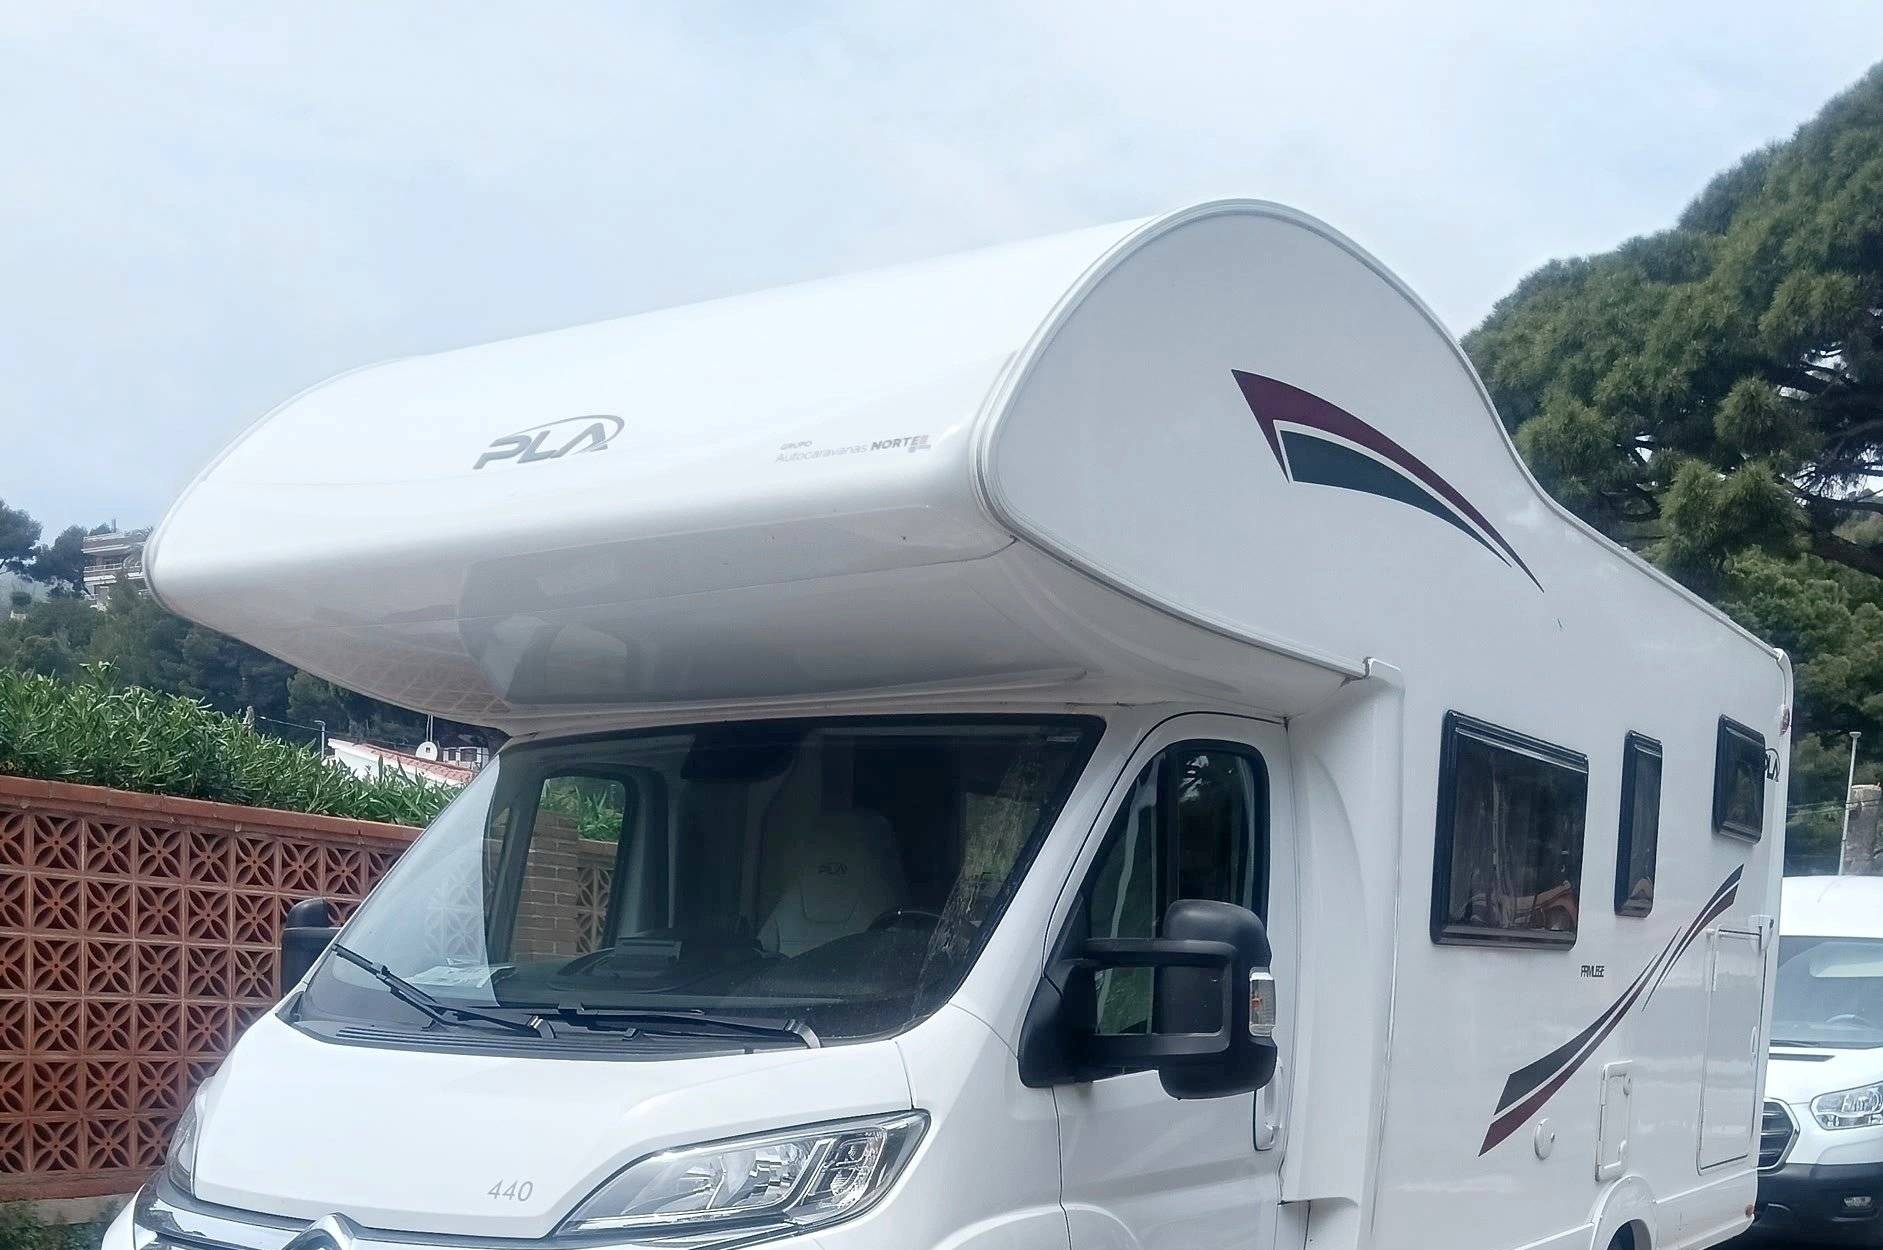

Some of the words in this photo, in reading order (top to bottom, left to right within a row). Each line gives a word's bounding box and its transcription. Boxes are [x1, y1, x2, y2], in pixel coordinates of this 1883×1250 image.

[472, 419, 614, 470] PLA
[870, 434, 920, 452] NORTE
[486, 1178, 534, 1203] 440
